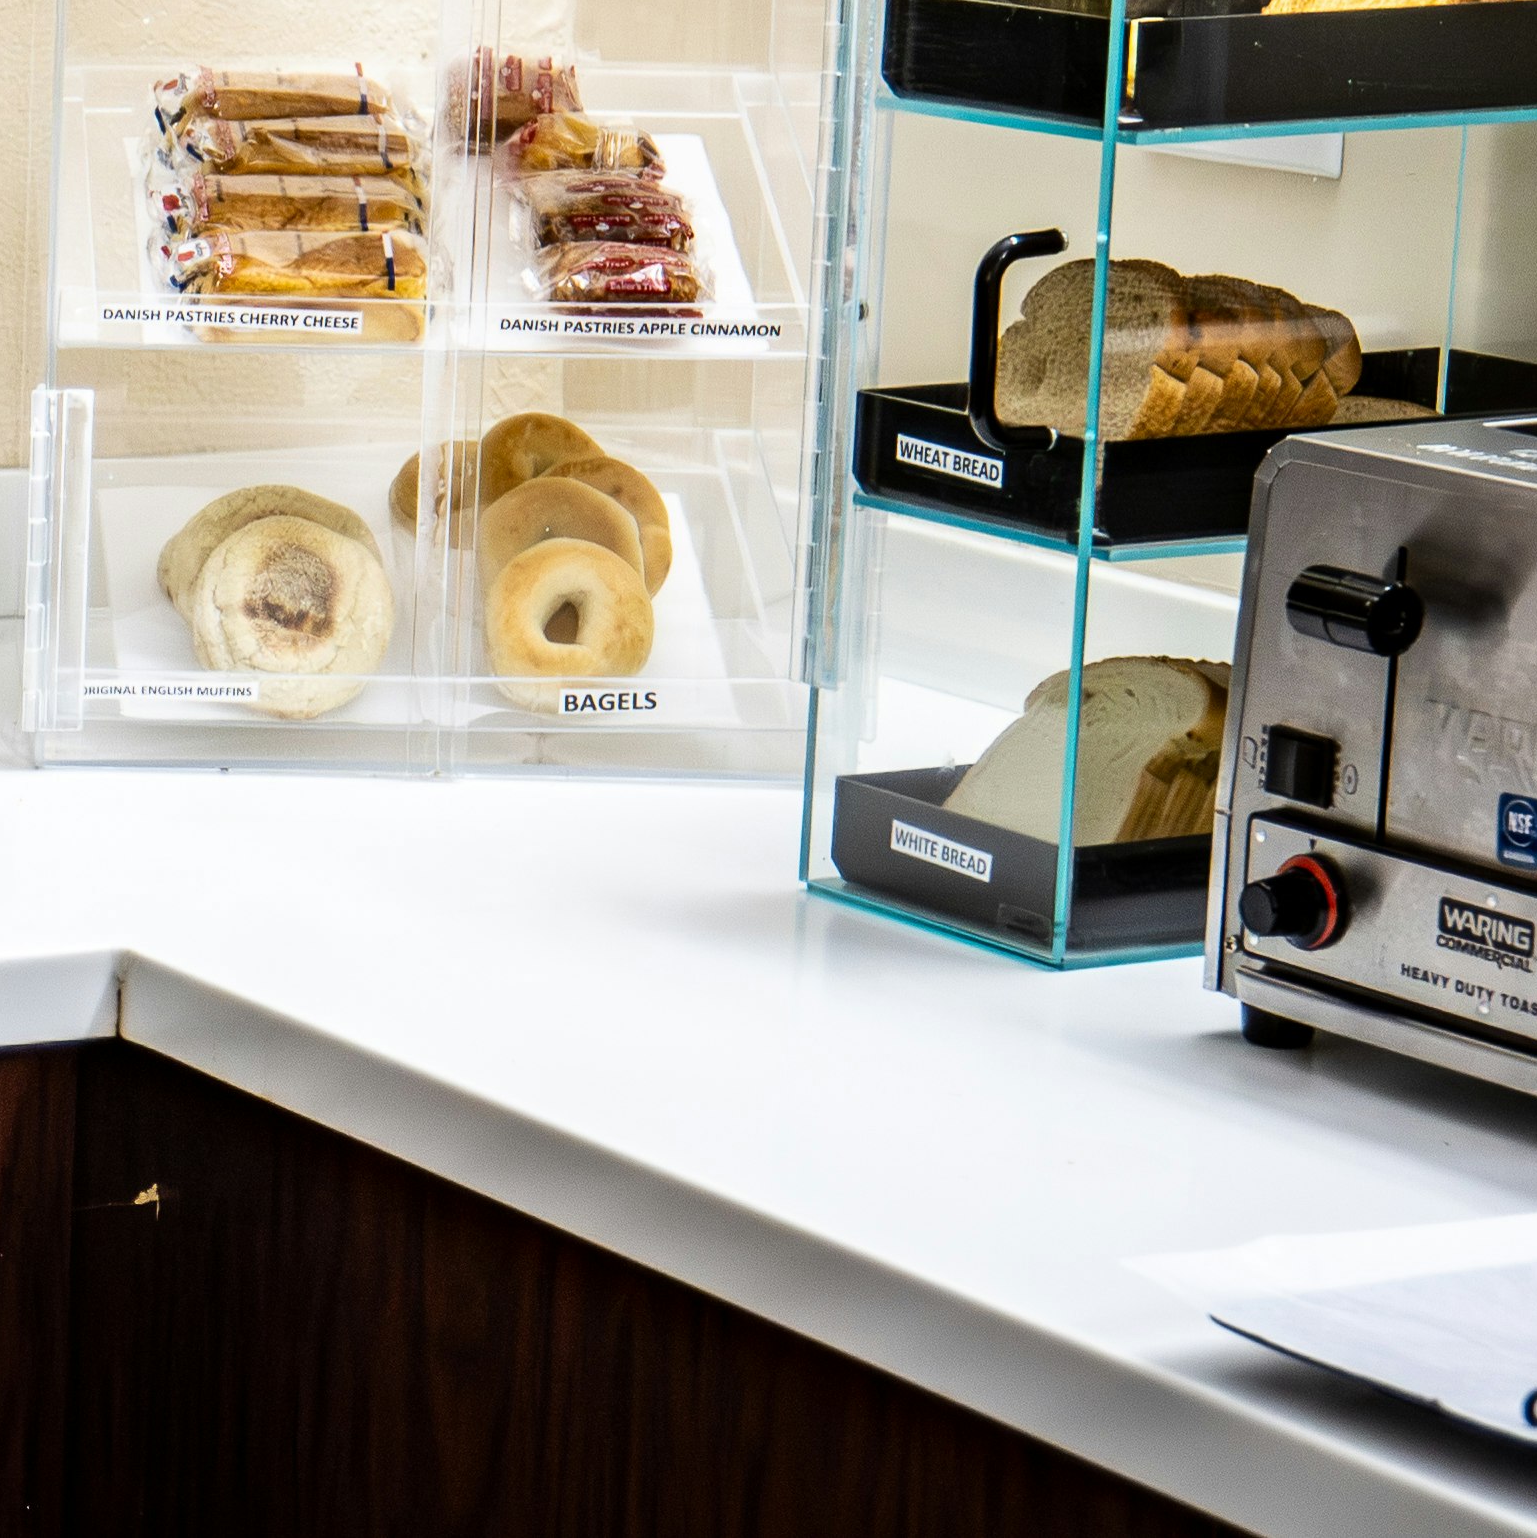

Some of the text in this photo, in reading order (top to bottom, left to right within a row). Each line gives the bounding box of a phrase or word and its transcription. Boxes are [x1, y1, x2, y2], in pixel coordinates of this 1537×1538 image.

[102, 307, 359, 330] DANISH PASTRIES CHERRY CHEESE
[500, 318, 782, 338] DANISH PASTRIES APPLE CINNAMON
[898, 438, 1000, 484] WHEAT BREAD
[141, 685, 193, 697] ENGLISH
[196, 686, 253, 697] MUFFINS
[563, 691, 658, 713] BAGELS
[1508, 810, 1535, 835] NSF
[894, 826, 988, 876] WHITE BREAD
[1442, 904, 1532, 950] WARING
[1436, 934, 1534, 975] COMMERCIAL
[1400, 962, 1449, 990] HEAVY
[1455, 979, 1494, 1003] DUTY
